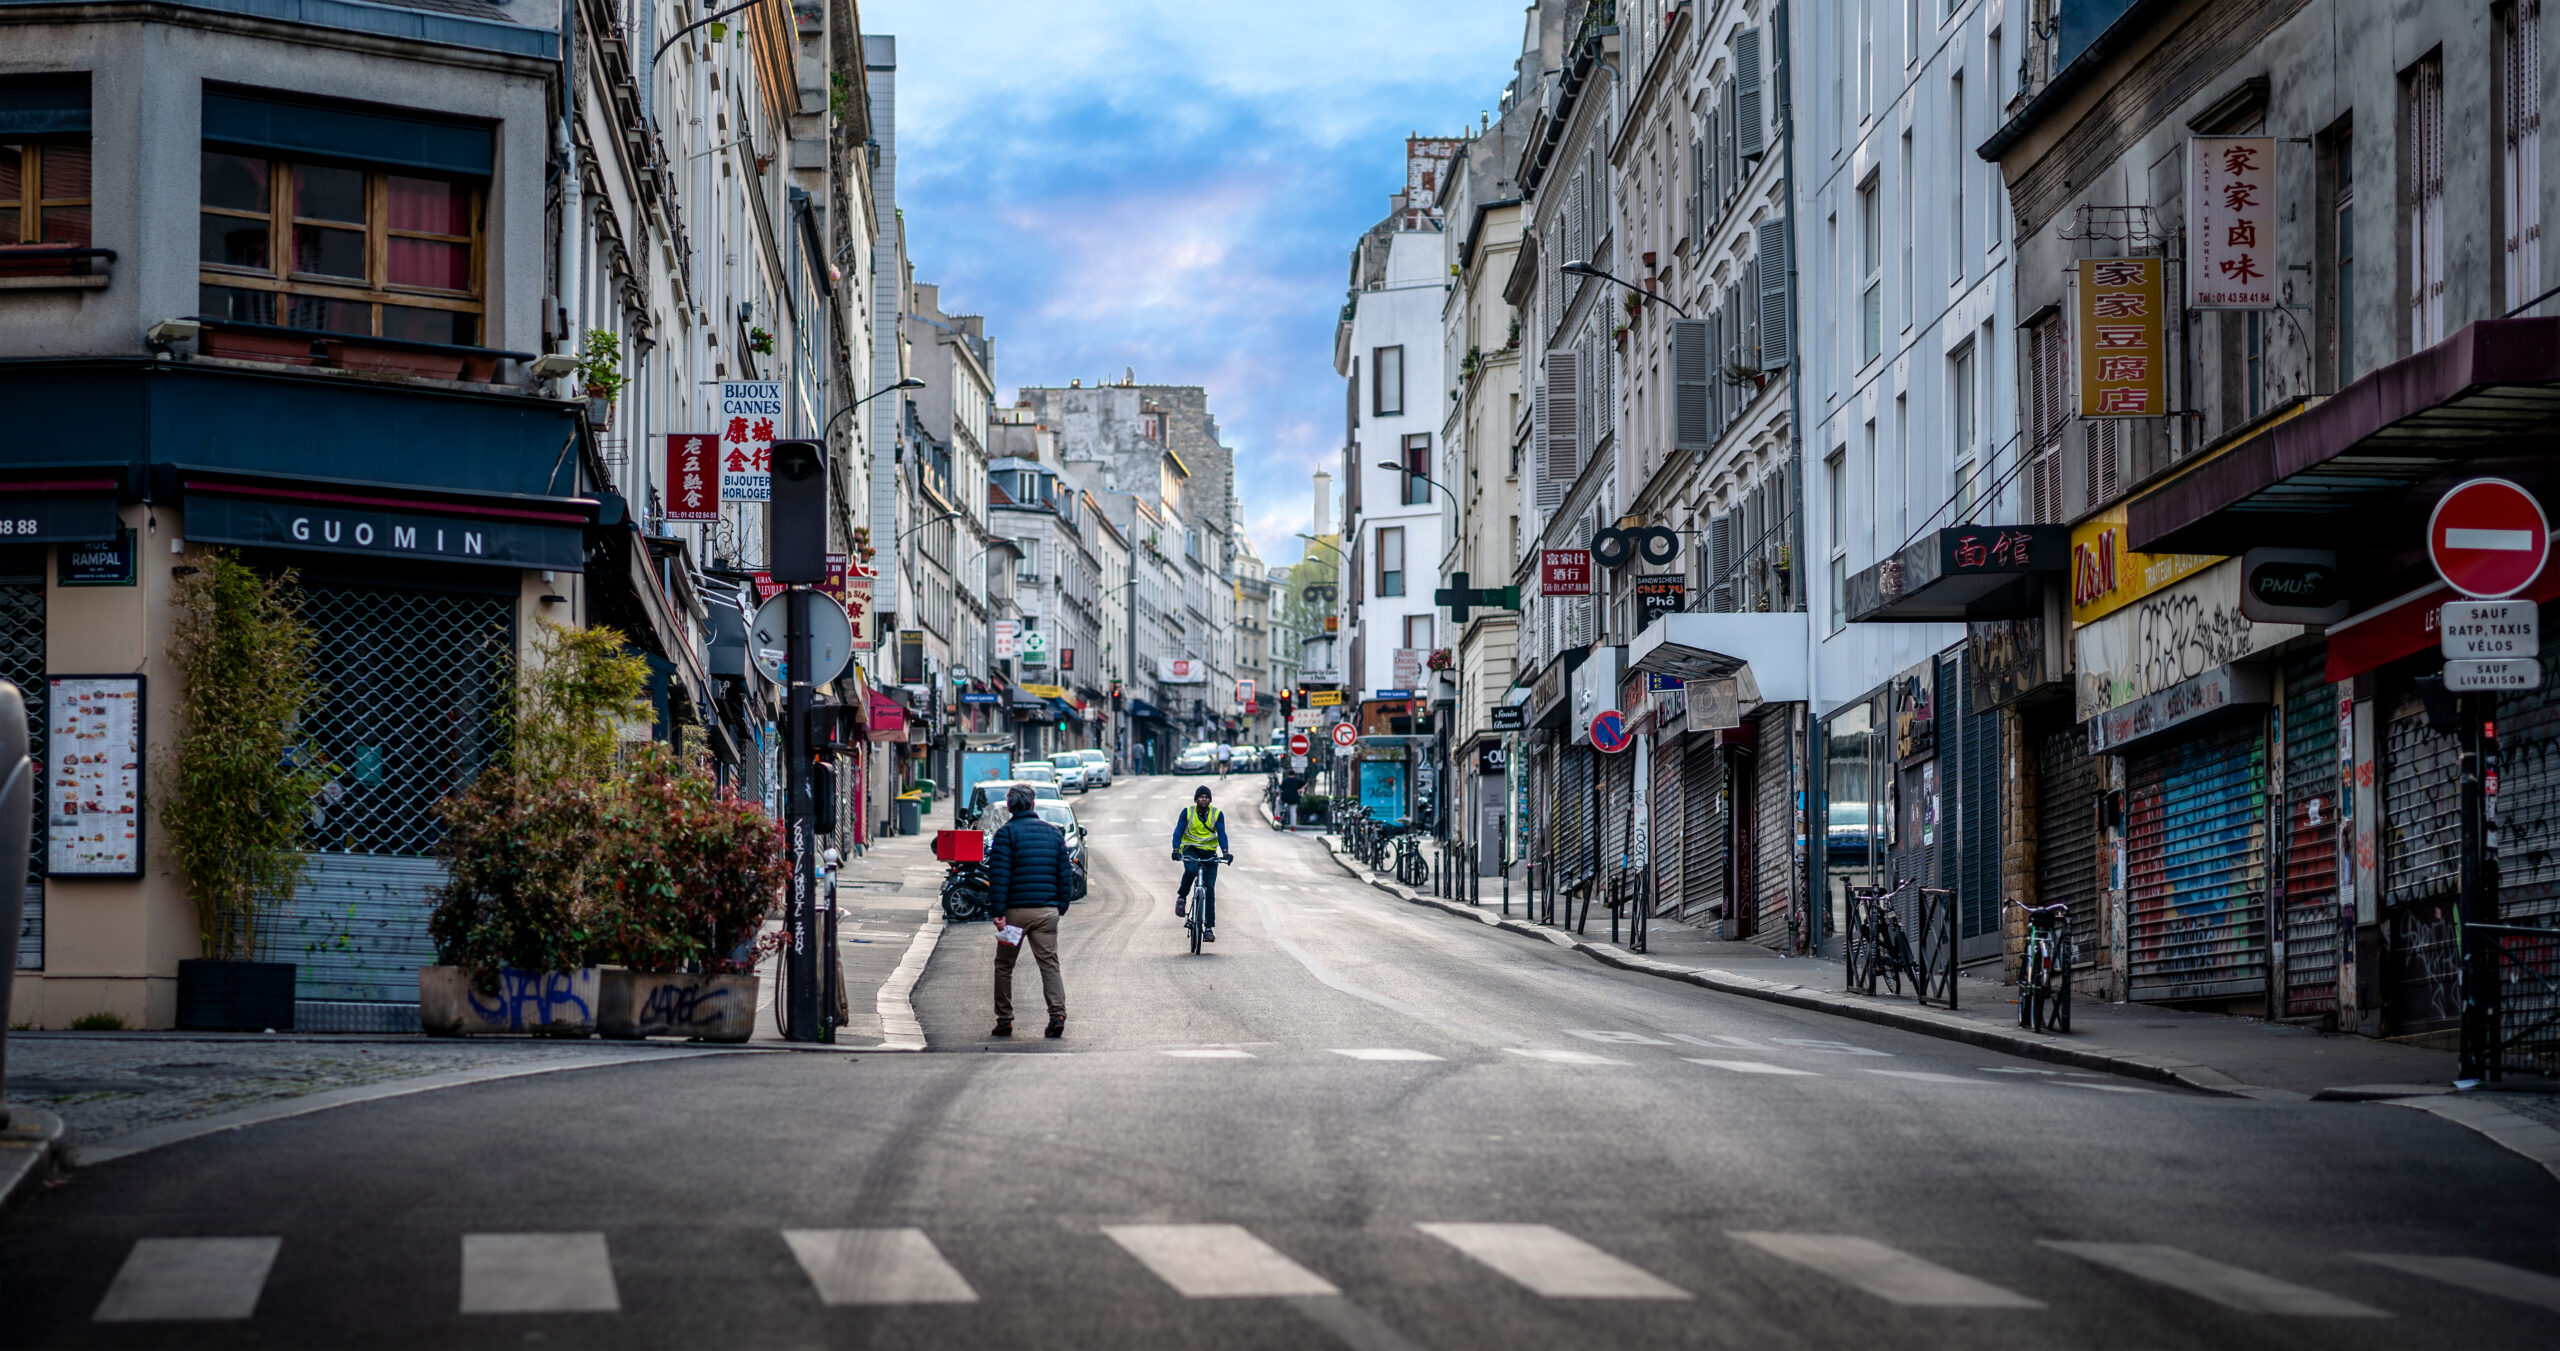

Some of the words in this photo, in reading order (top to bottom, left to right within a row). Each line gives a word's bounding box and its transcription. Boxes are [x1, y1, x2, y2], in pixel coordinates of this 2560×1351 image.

[2219, 145, 2264, 285] 家家卤味
[2217, 293, 2226, 303] 01
[2227, 293, 2237, 303] 43
[2249, 293, 2259, 303] 41
[2260, 293, 2270, 303] 84
[2093, 261, 2148, 413] 家家豆腐店
[725, 384, 779, 398] BIJOUX
[724, 400, 781, 414] CANNES
[724, 416, 777, 444] 康城
[17, 519, 38, 535] 88
[292, 517, 482, 554] GUOMIN
[72, 552, 121, 566] RAMPAL
[2074, 528, 2117, 606] Z&M
[1554, 568, 1580, 581] 酒行
[2260, 577, 2301, 593] PMU
[853, 590, 872, 603] SIAM
[1646, 595, 1675, 606] Phô
[2471, 608, 2508, 619] SAUF
[2449, 625, 2488, 636] RATP,
[2491, 624, 2531, 635] TAXIS
[2468, 639, 2513, 651] VÉLOS
[952, 668, 966, 676] BUS
[2477, 664, 2508, 674] SAUF
[2460, 676, 2525, 685] LIVRAISON
[1495, 709, 1517, 718] Sonia
